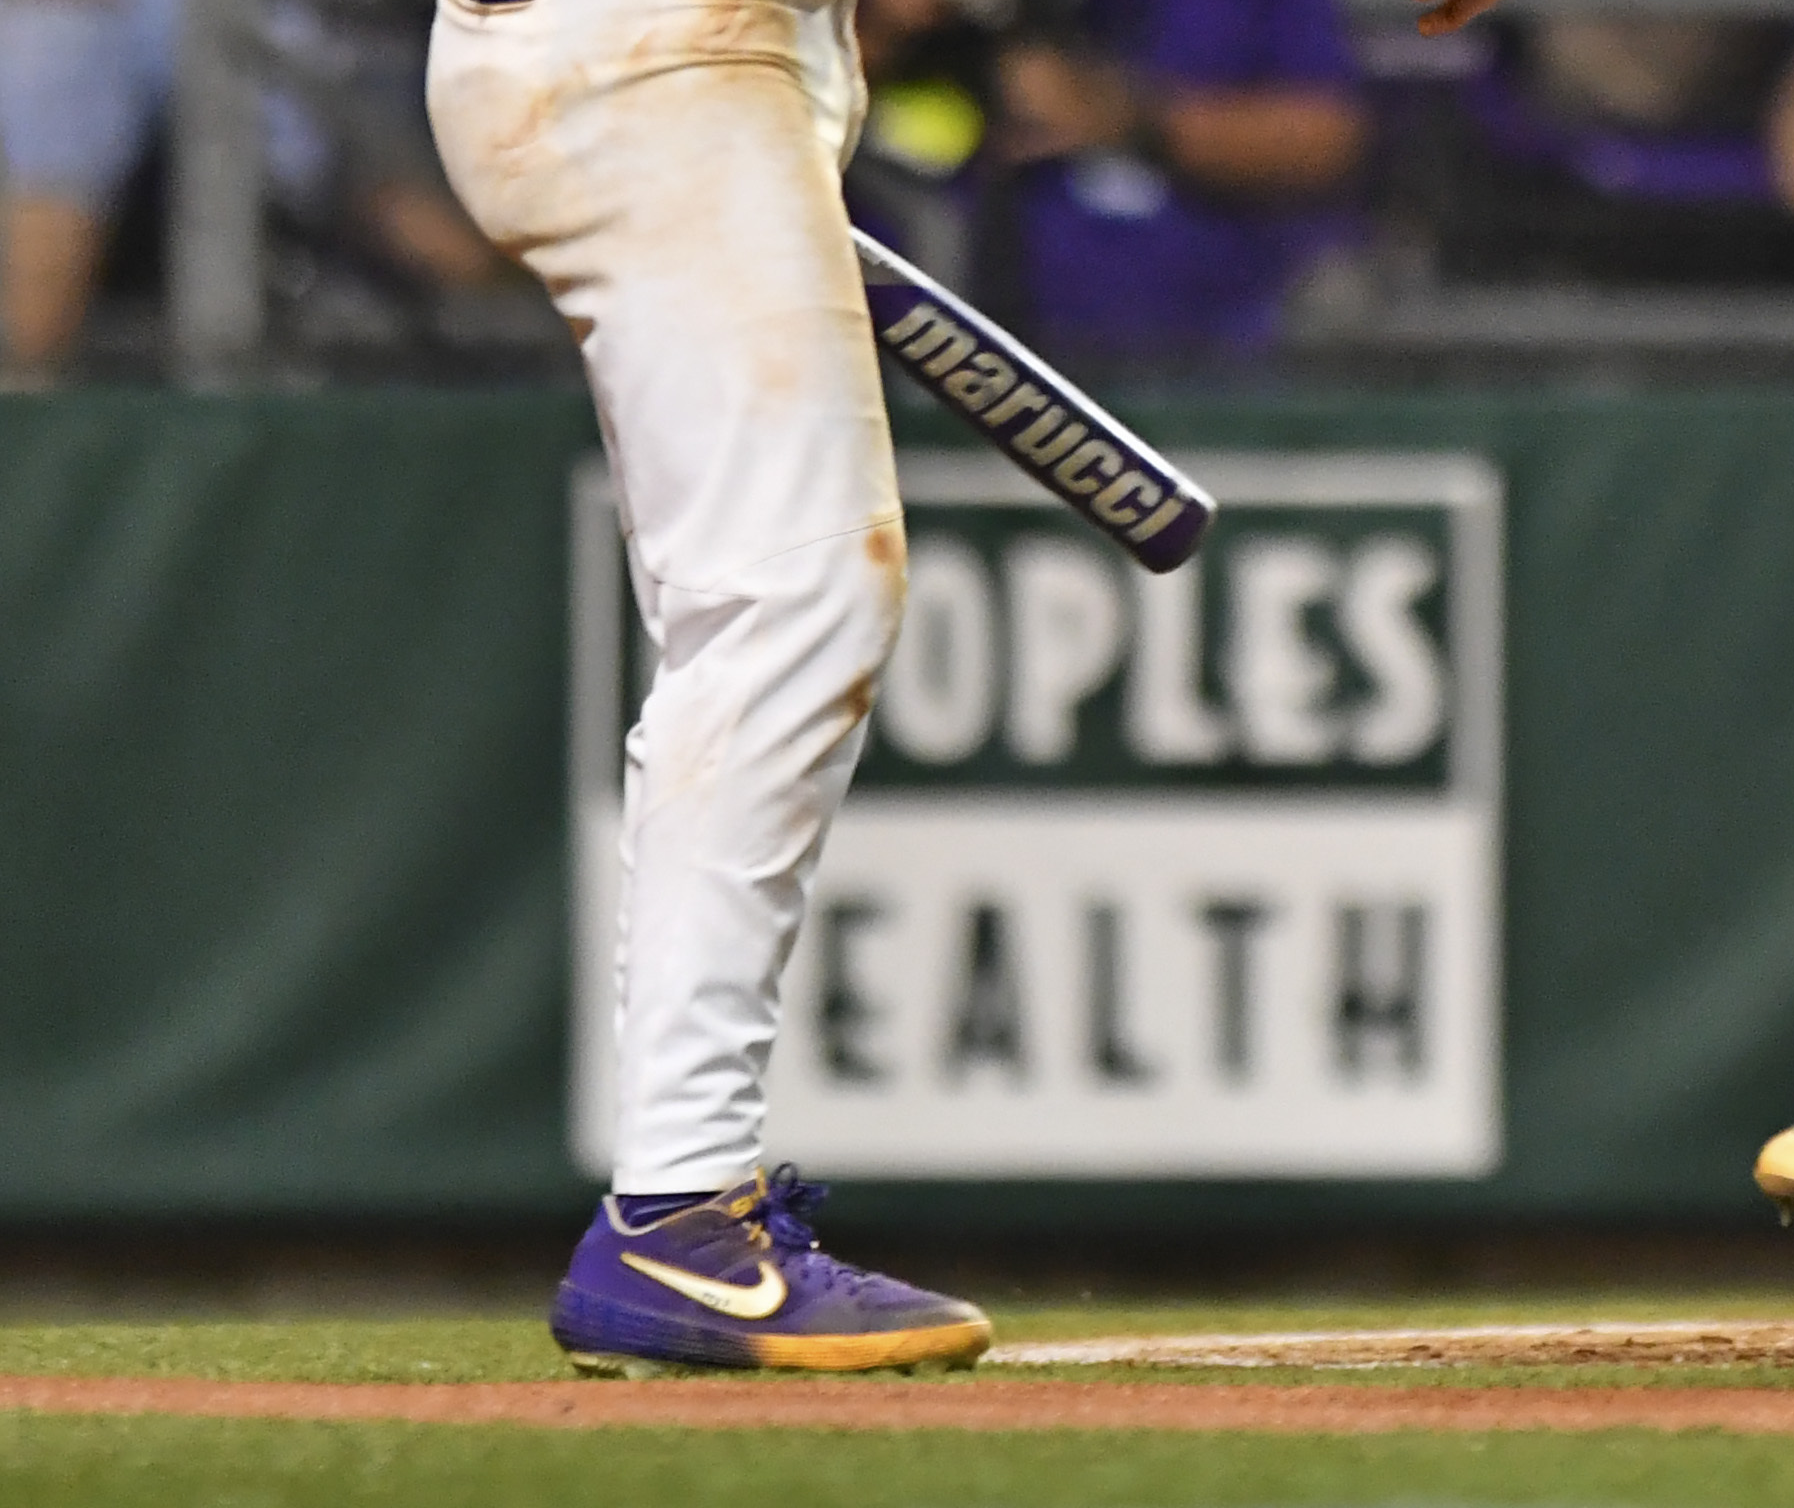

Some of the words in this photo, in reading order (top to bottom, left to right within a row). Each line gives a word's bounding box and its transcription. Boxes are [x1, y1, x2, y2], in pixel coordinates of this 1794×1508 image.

[882, 301, 1187, 544] marucci
[874, 532, 1449, 767] OPLES
[815, 893, 1434, 1086] EALTH
